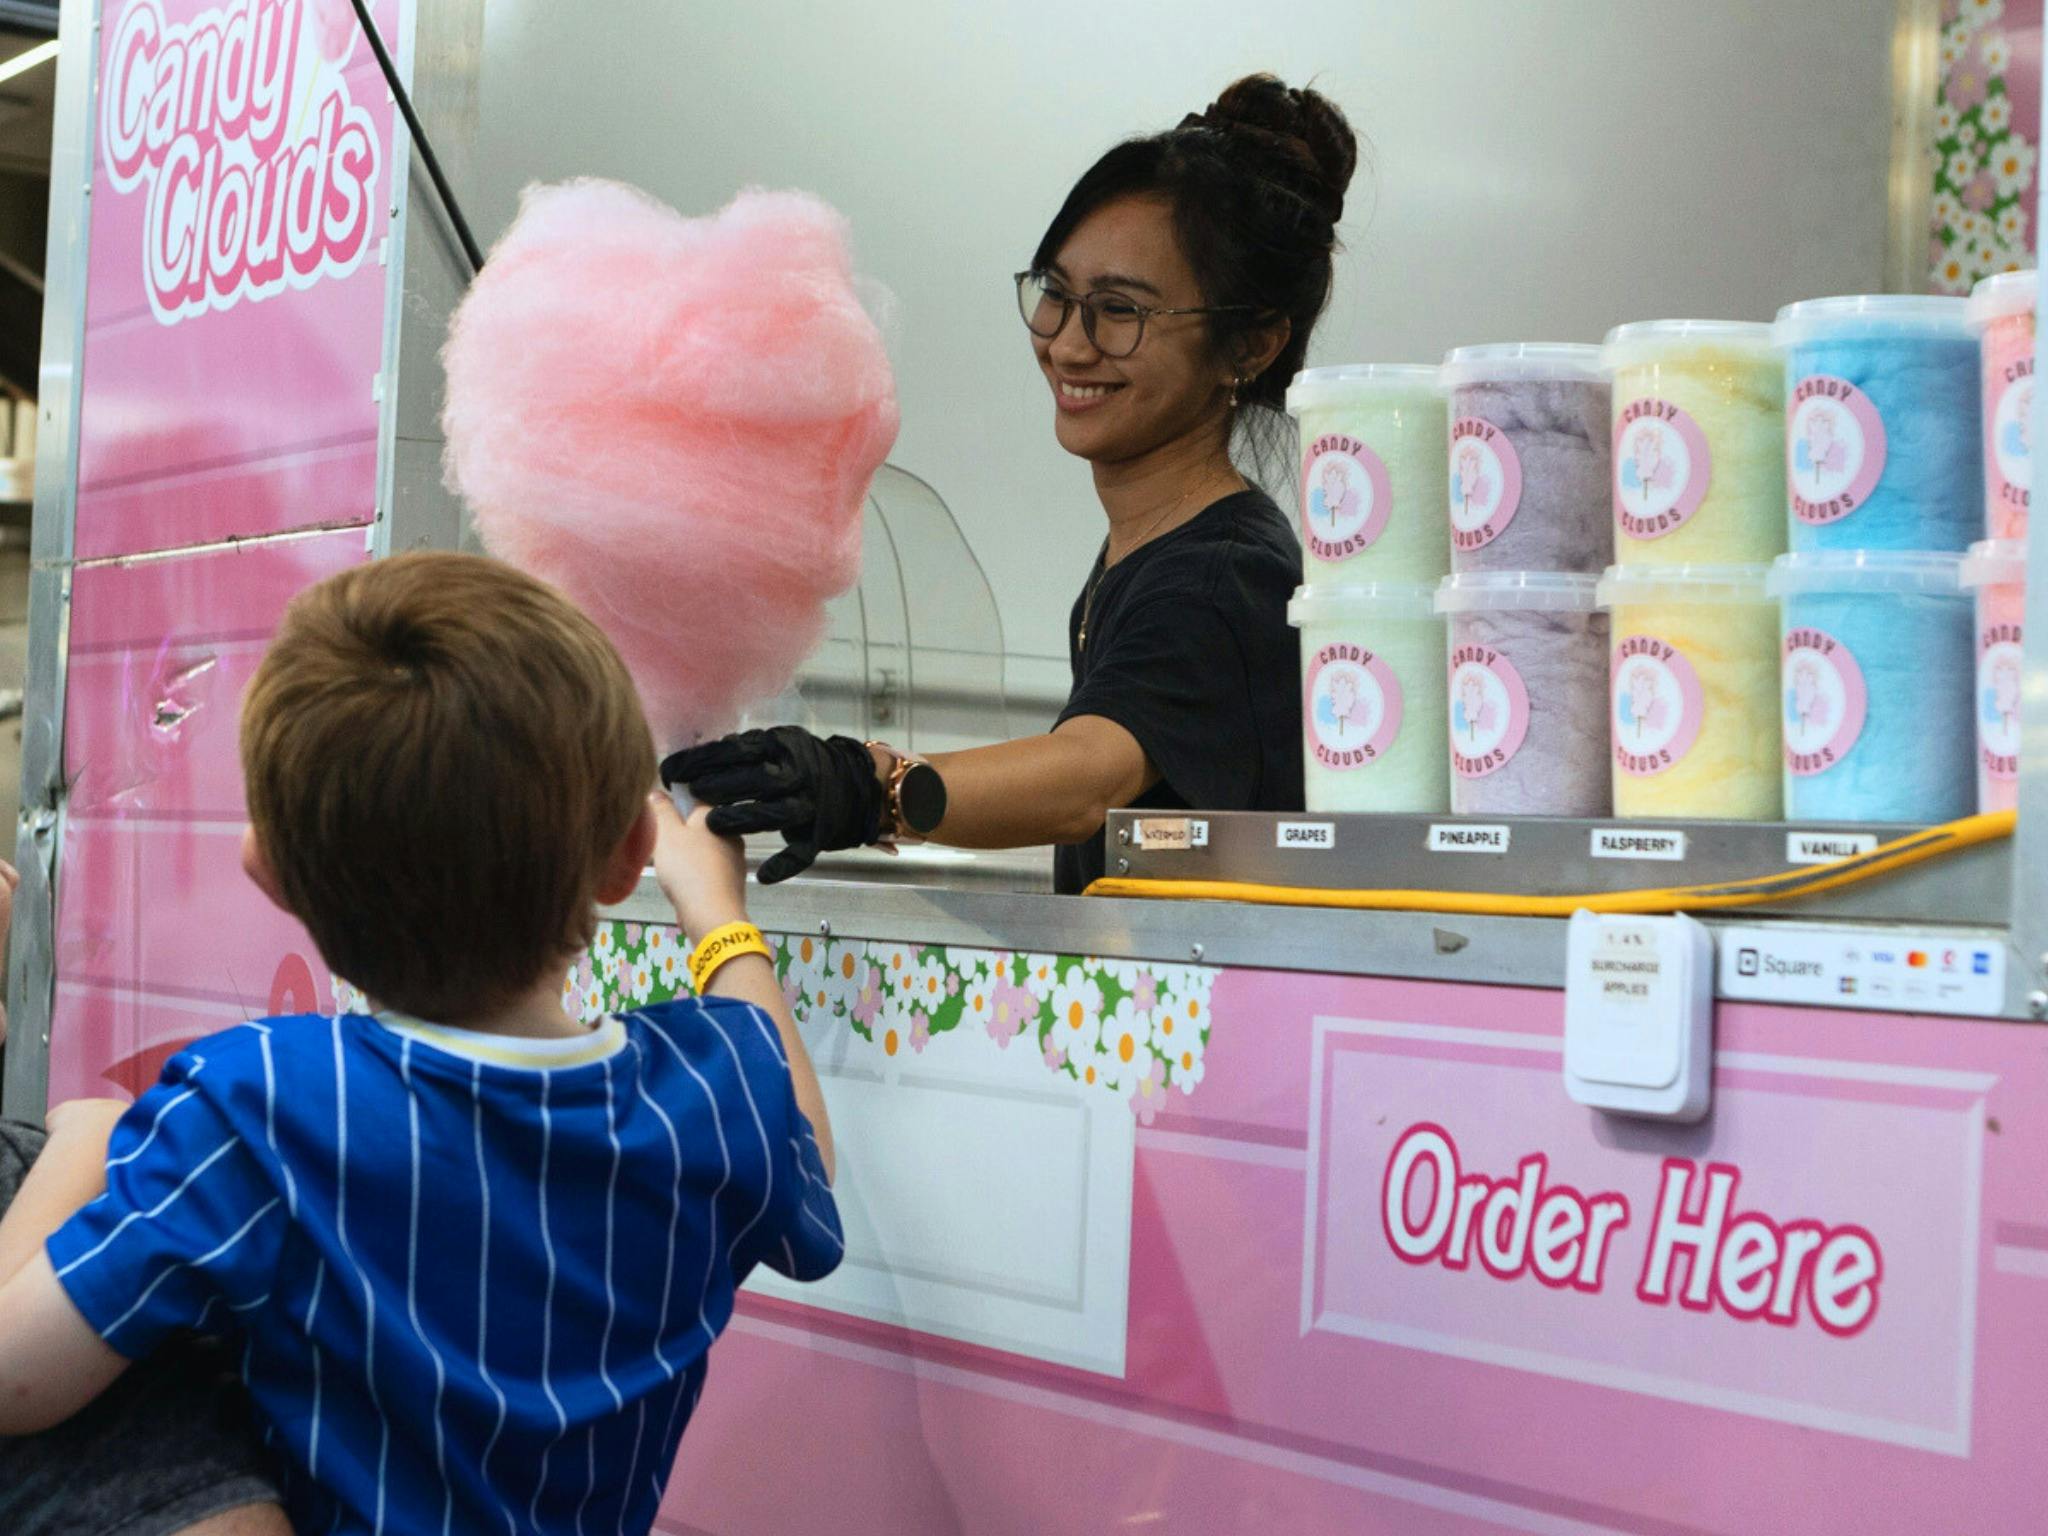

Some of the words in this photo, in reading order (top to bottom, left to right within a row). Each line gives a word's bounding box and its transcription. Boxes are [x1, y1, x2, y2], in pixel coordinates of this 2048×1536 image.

[106, 0, 300, 174] Candy
[149, 92, 373, 308] Clouds
[1797, 379, 1852, 401] CANDY
[1624, 400, 1678, 423] CANDY
[1453, 420, 1495, 441] CANDY
[1312, 437, 1363, 457] CANDY
[1622, 508, 1681, 533] CLOUDS
[1311, 534, 1367, 557] CLOUDS
[1984, 625, 2022, 648] CAND
[1320, 645, 1374, 665] CANDY
[1453, 647, 1496, 668] CANDY
[1622, 639, 1674, 661] CANDY
[1317, 744, 1376, 766] CLOUDS
[1618, 746, 1671, 772] CLOUDS
[1286, 828, 1327, 842] GRAPES
[1440, 831, 1501, 846] PINEAPPLE
[1601, 836, 1676, 852] RASPBERRY
[1801, 840, 1858, 856] VANILLA
[1591, 959, 1659, 974] SURCHARGE
[1763, 953, 1824, 979] Square
[1603, 981, 1650, 997] APPLIES
[1382, 1120, 1631, 1292] Order
[1636, 1155, 1884, 1338] Here
